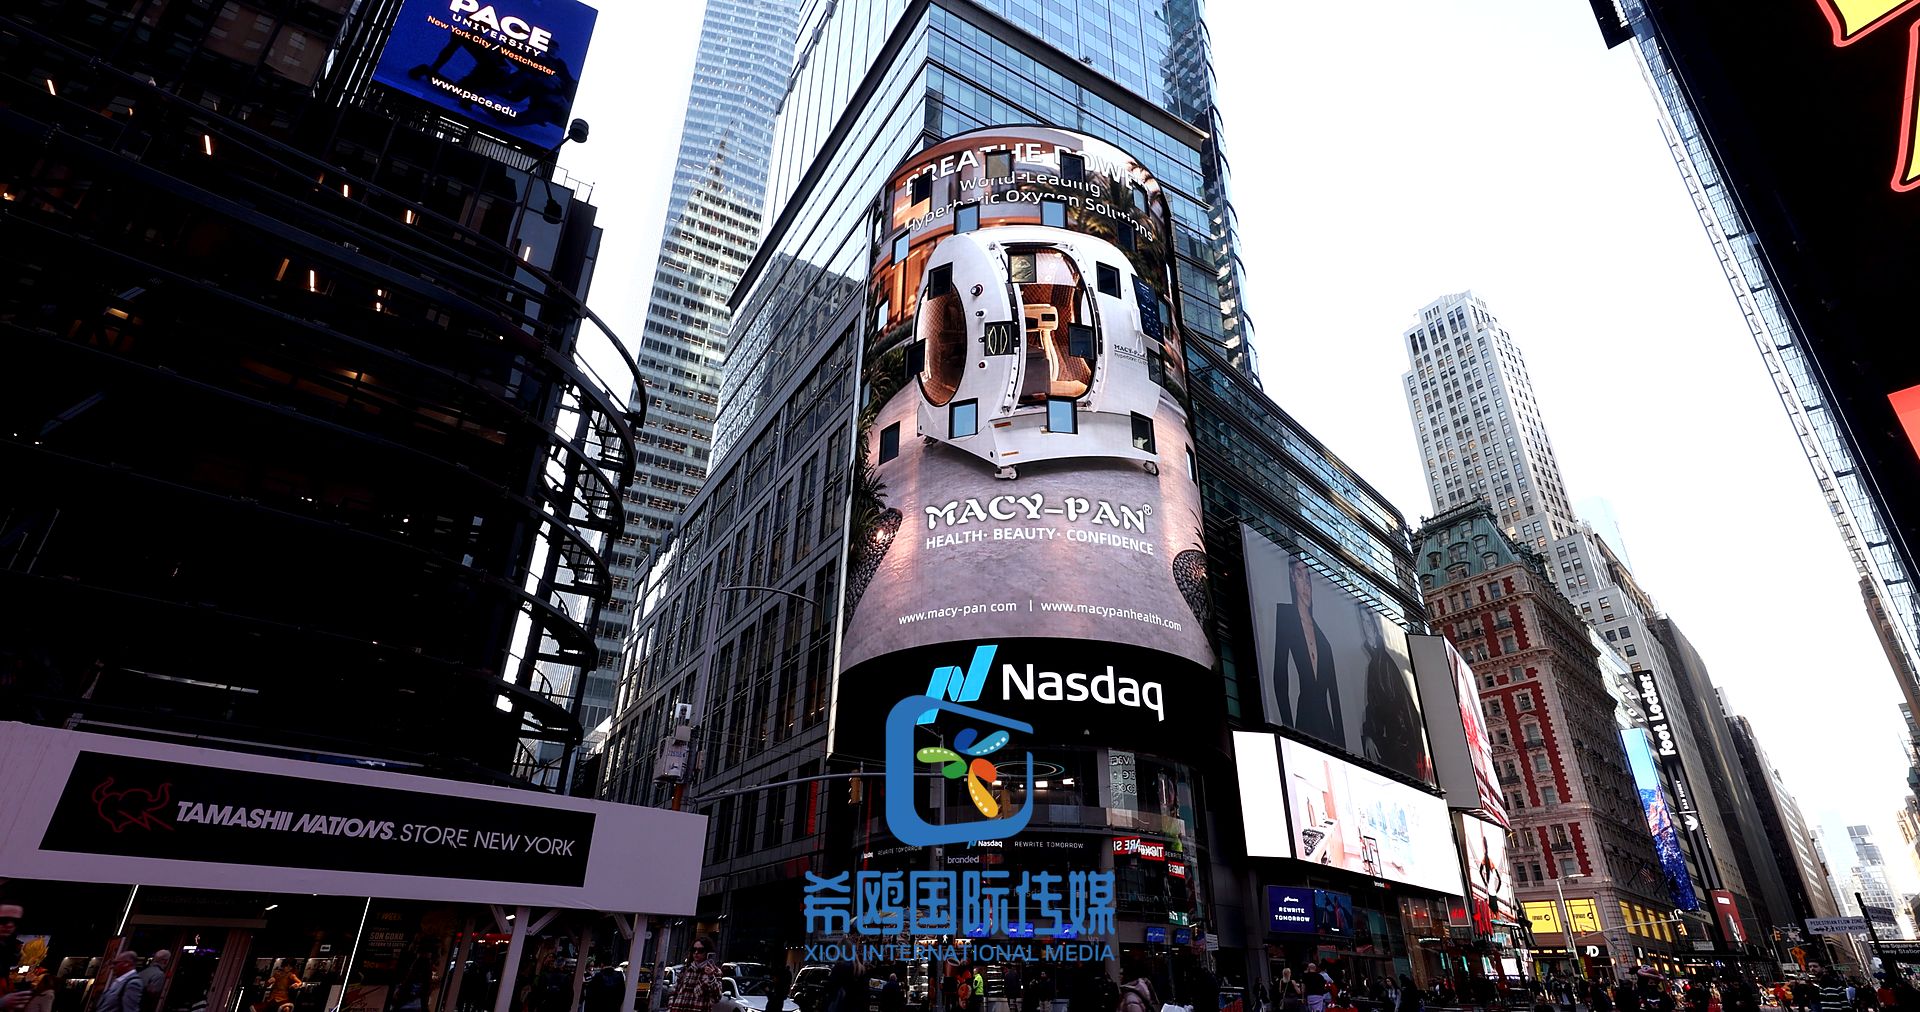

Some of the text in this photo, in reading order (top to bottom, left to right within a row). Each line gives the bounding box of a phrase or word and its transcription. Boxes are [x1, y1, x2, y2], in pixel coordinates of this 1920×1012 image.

[427, 15, 450, 30] New
[451, 23, 471, 40] York
[472, 35, 492, 49] City
[500, 47, 556, 76] Westchester
[449, 0, 552, 52] PACE
[452, 16, 541, 57] UNIVERSITY
[431, 76, 518, 118] www.pace.edu
[1066, 529, 1154, 556] CONFIDENCE
[1041, 601, 1182, 632] www.macypanhealth.com
[1002, 663, 1164, 722] Nasdaq
[1639, 673, 1677, 757] Foot Locker
[176, 801, 576, 857] TAMASHII NATIONS STORE NEW YORK
[978, 840, 1003, 848] Nasdaq
[1046, 841, 1084, 849] TOMORROW
[947, 856, 980, 864] branded
[1274, 914, 1310, 922] TOMORROW
[1278, 906, 1305, 914] REWRITE
